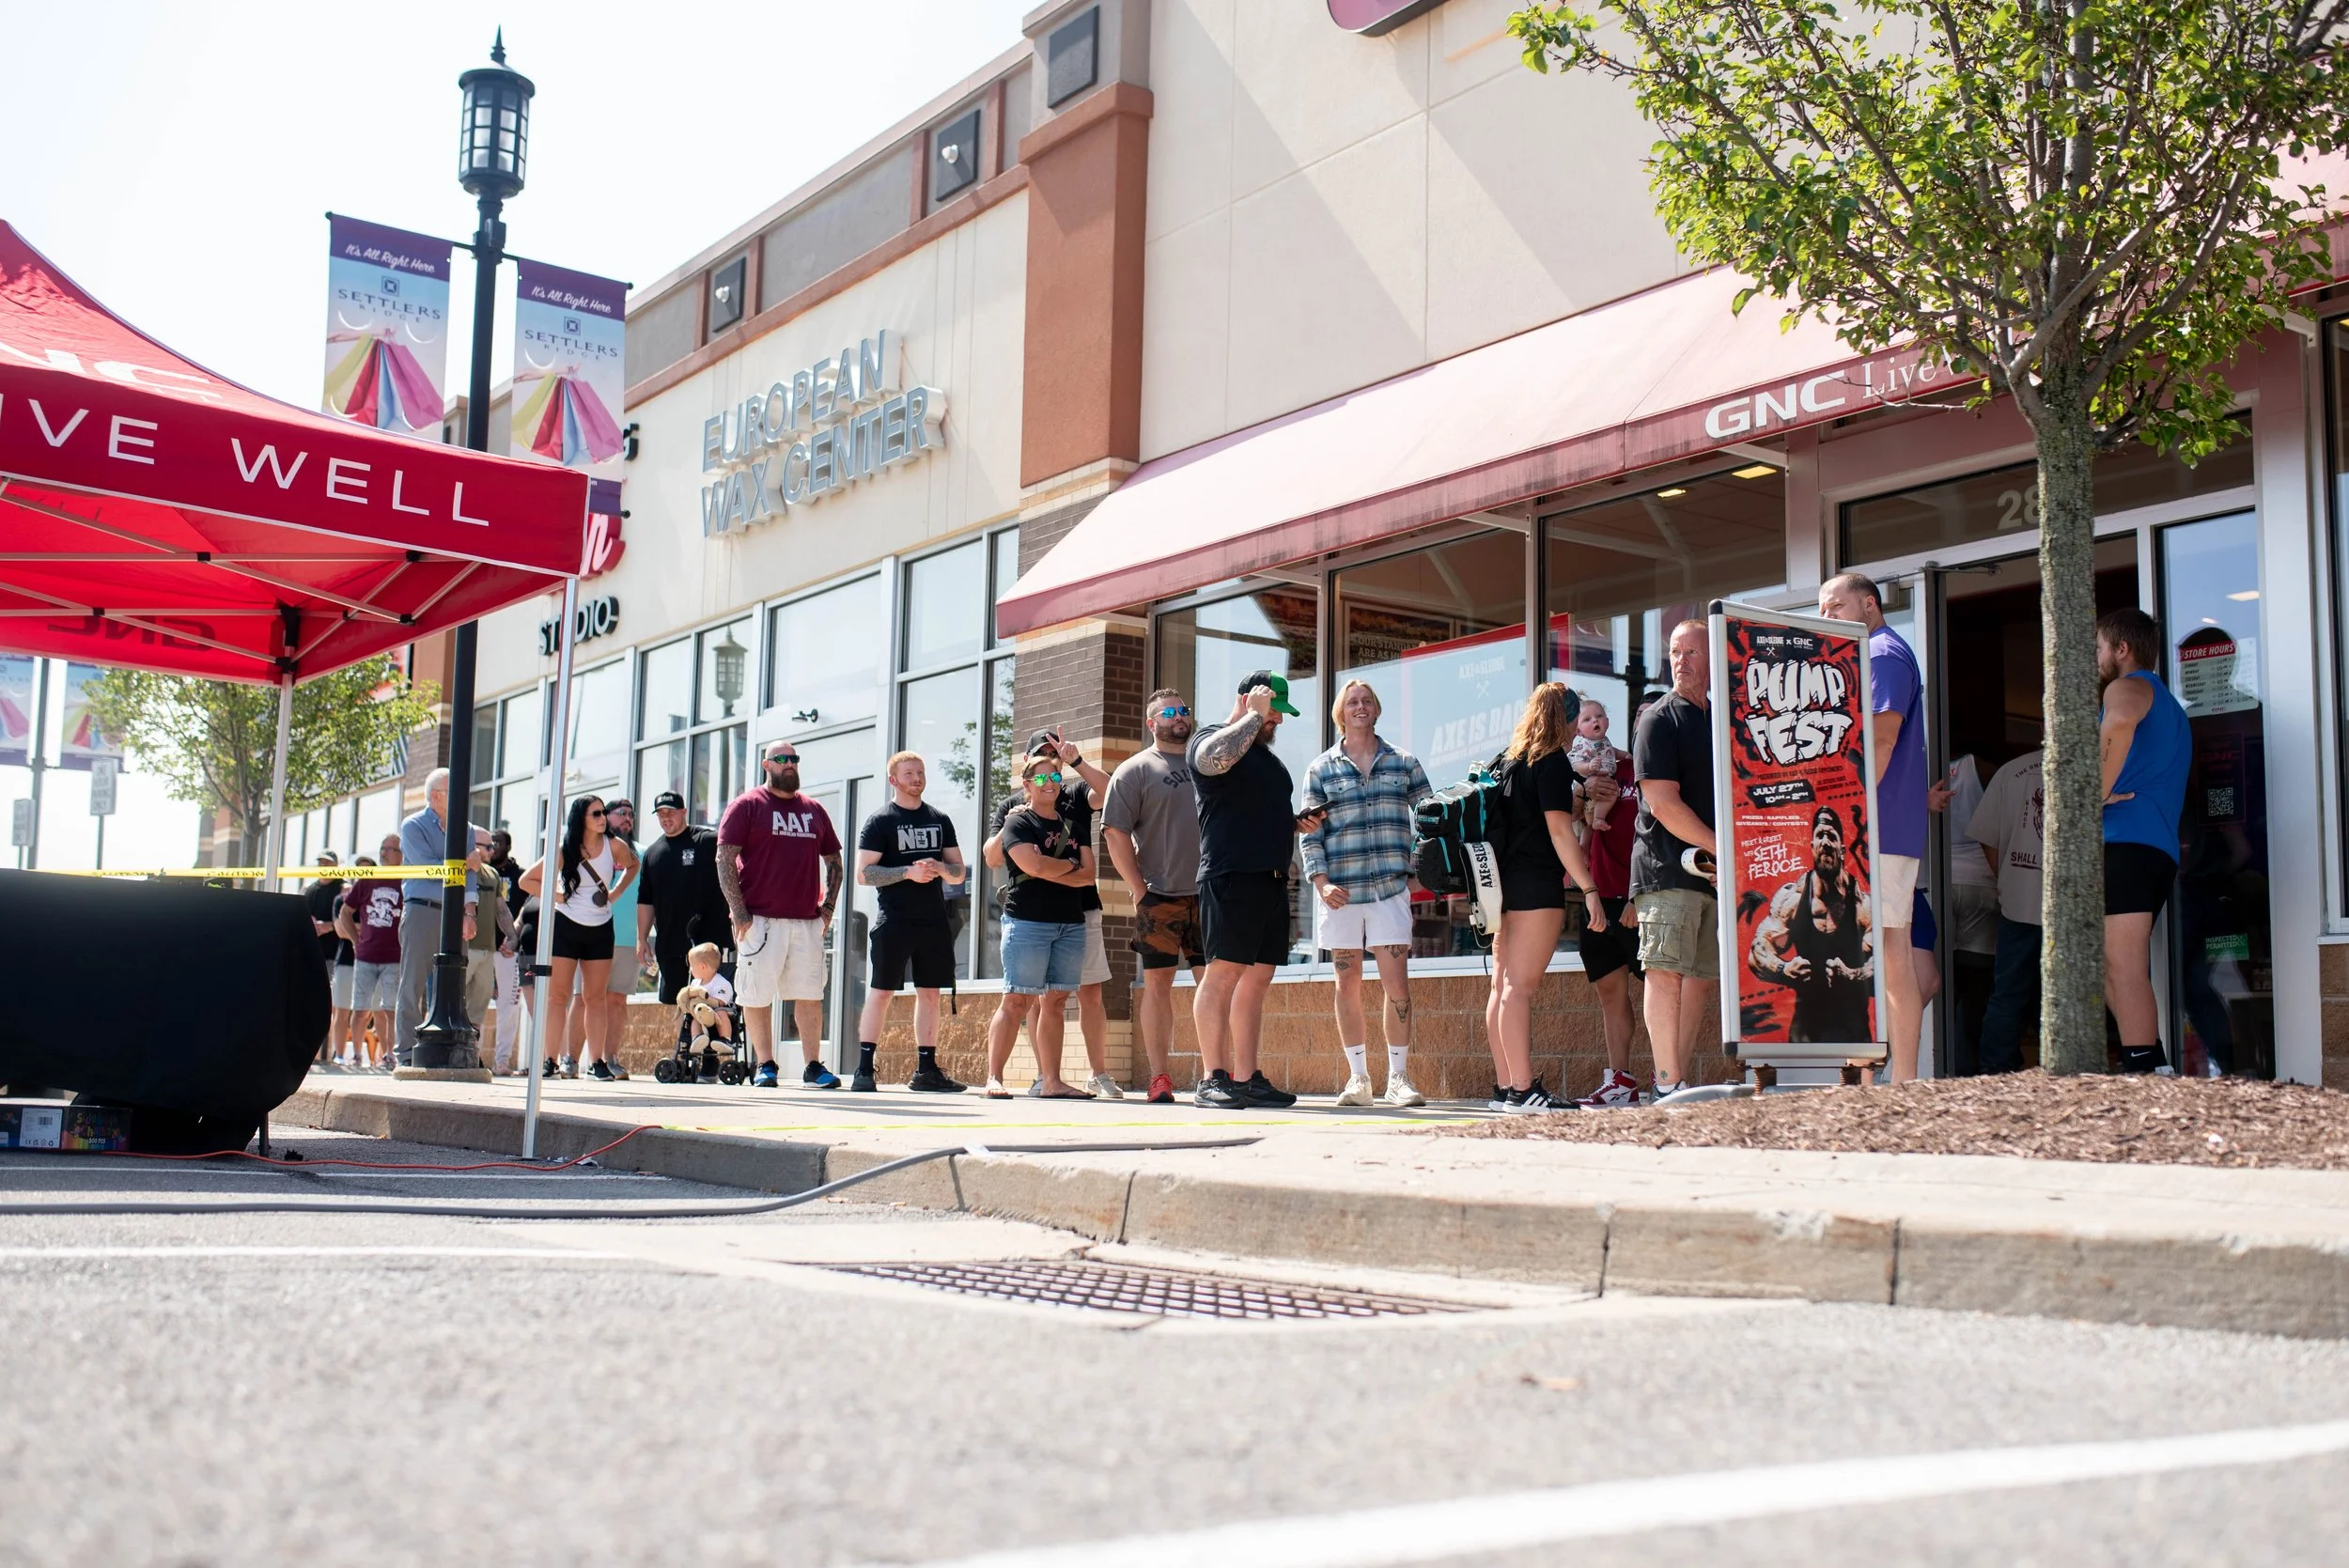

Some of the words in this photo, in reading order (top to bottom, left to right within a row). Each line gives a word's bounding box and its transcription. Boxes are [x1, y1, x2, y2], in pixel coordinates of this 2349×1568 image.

[345, 243, 361, 257] It's
[363, 247, 380, 261] All
[381, 251, 410, 270] Right
[410, 258, 436, 273] Here
[338, 287, 442, 320] SETTLERS
[359, 303, 423, 324] RIDGE
[531, 285, 545, 299] It's
[547, 289, 562, 303] All
[563, 292, 589, 310] Right
[590, 299, 612, 314] Here
[524, 329, 618, 358] SETTLERS
[543, 343, 601, 362] RIDGE
[702, 328, 889, 474] EUROPEAN
[1703, 369, 1846, 440] GNC
[1860, 355, 1938, 400] Live
[782, 385, 936, 505] CENTER
[0, 393, 158, 465] VE
[230, 437, 490, 527] WELL
[701, 456, 779, 540] WAX
[538, 596, 615, 657] STDIO
[1358, 647, 1376, 658] ARE
[1793, 637, 1813, 646] GNC
[2184, 648, 2207, 660] STORE
[2208, 643, 2234, 656] HOURS
[1746, 658, 1846, 712] PUMP
[1429, 718, 1467, 755] AXE
[1488, 698, 1525, 738] BAC
[1744, 708, 1853, 765] FEST
[1162, 768, 1192, 789] SQU
[1753, 785, 1777, 797] JULY
[1778, 782, 1804, 793] 27TH
[1765, 794, 1785, 804] 10AM
[1792, 791, 1809, 800] 2PM
[1753, 842, 1787, 862] SETH
[2011, 851, 2037, 864] SHALL
